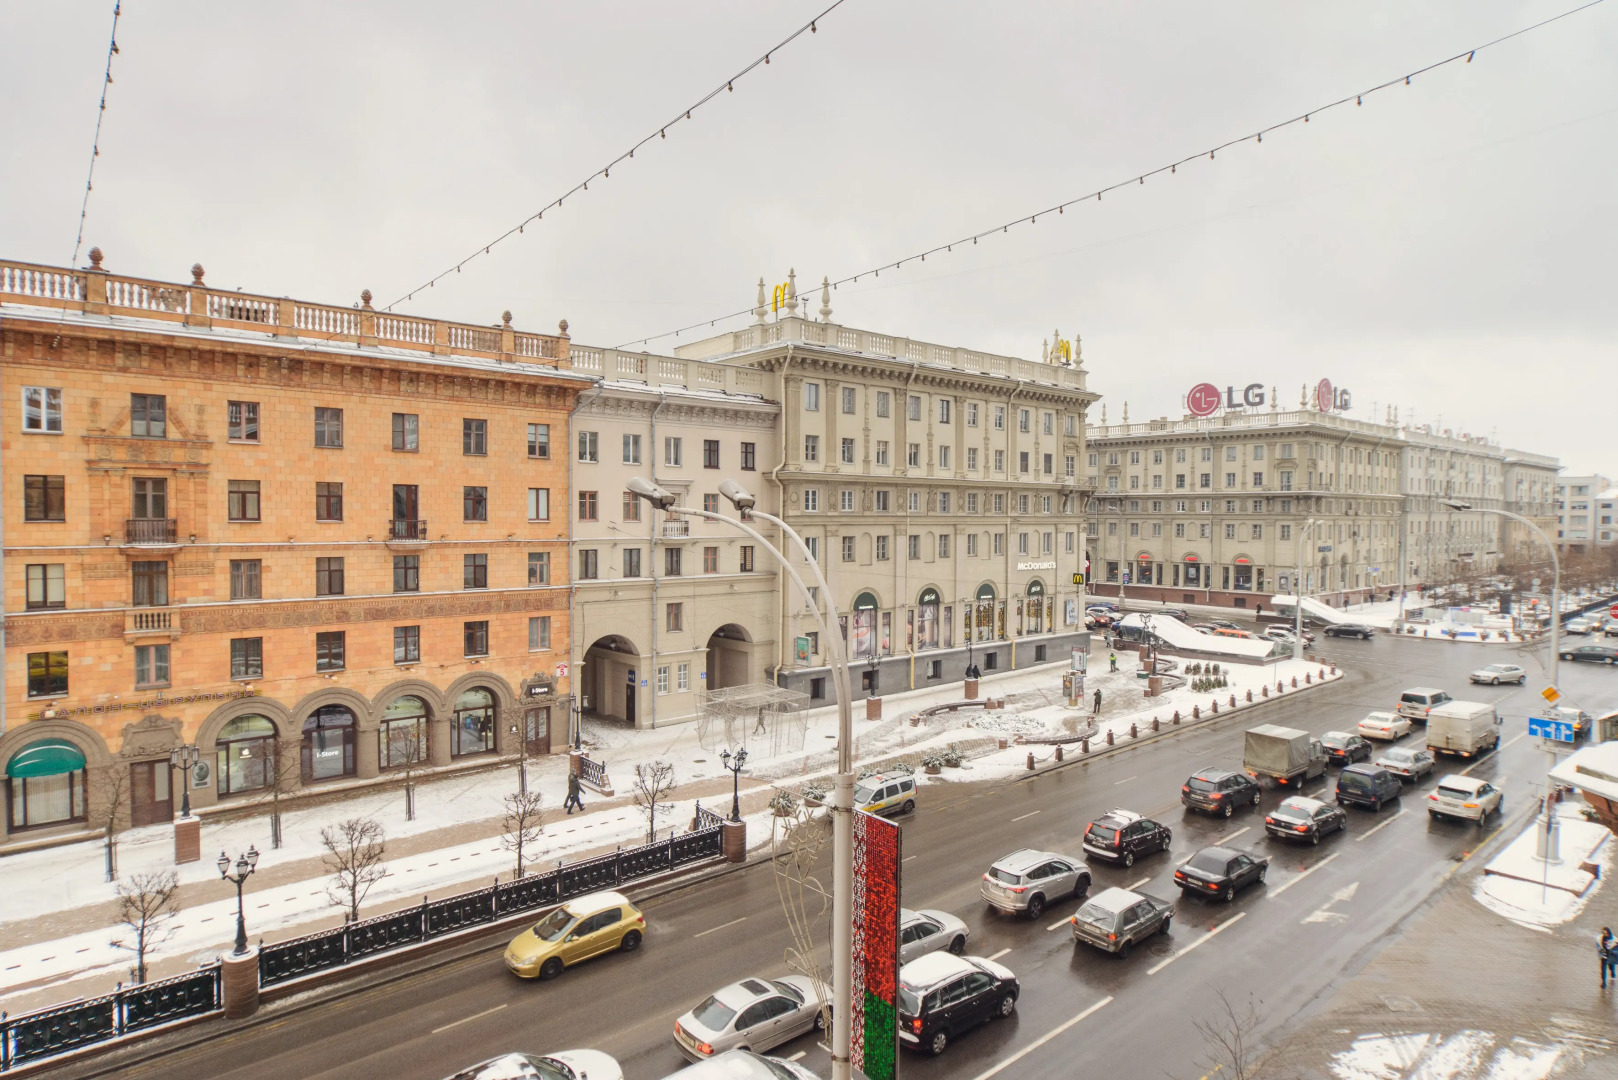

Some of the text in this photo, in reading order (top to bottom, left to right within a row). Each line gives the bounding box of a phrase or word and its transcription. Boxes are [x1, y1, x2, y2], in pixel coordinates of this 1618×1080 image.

[1227, 383, 1265, 408] LG
[1334, 386, 1350, 410] LG
[1016, 561, 1056, 571] McDonald's
